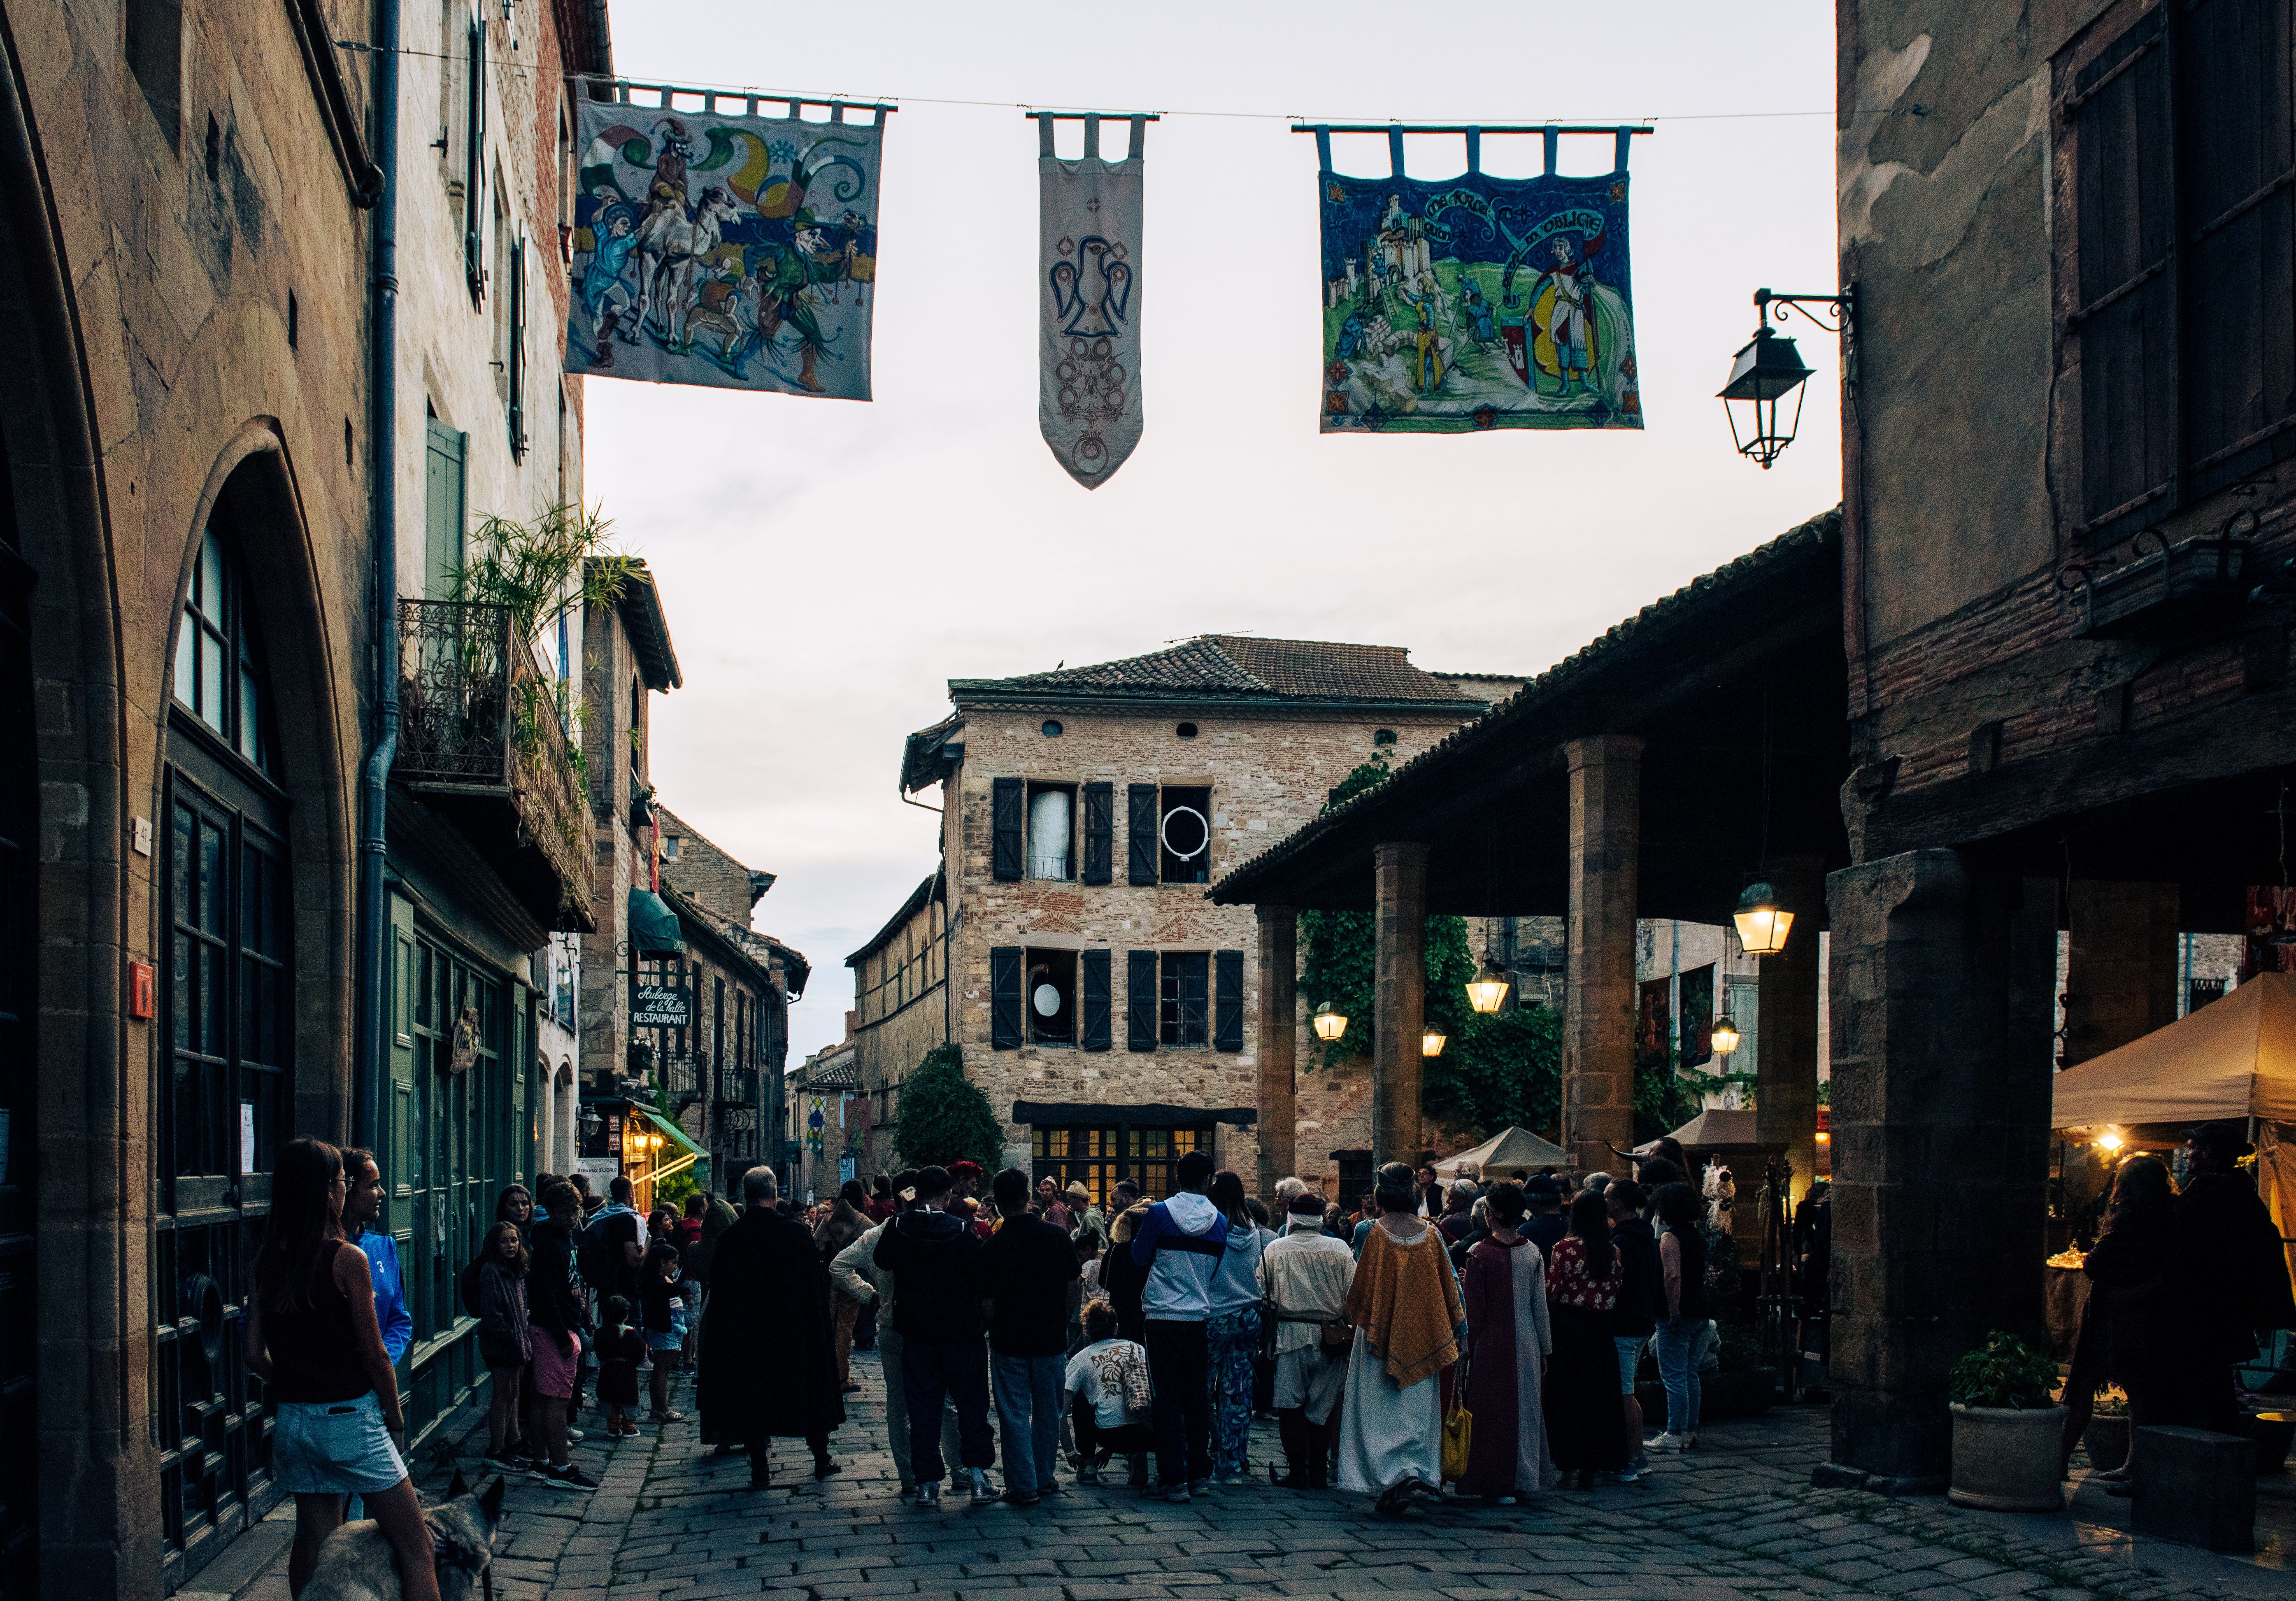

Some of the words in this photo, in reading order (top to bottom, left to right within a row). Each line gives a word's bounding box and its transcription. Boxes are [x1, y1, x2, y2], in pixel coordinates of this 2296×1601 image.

[141, 826, 147, 843] 41
[638, 986, 678, 1005] Auberge
[645, 1001, 656, 1011] de
[657, 1000, 665, 1012] la
[633, 1012, 688, 1024] RESTAURANT
[377, 1261, 384, 1273] 3
